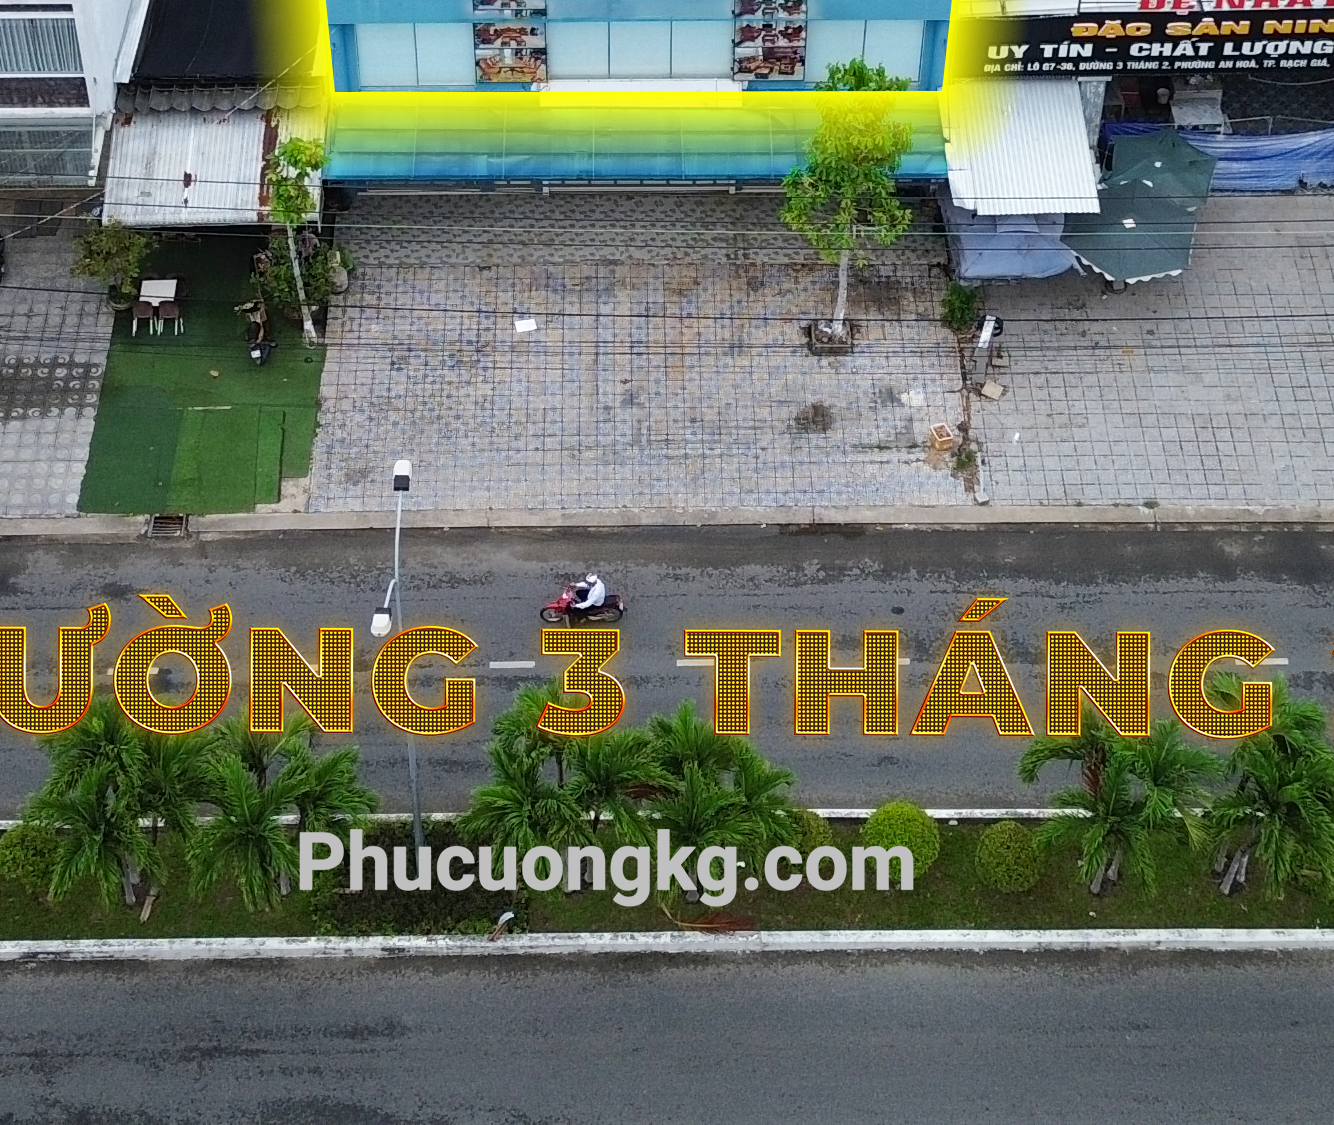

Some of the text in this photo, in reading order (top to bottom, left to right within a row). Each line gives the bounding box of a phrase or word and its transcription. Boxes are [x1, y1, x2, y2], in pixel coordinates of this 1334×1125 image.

[1071, 19, 1152, 39] ĐẶC
[987, 44, 1030, 60] UY
[1039, 40, 1094, 58] TÍN
[1129, 37, 1216, 57] CHẤT
[983, 63, 1001, 74] ĐỊA
[1027, 61, 1040, 72] LÔ
[1078, 59, 1114, 71] ĐƯỜNG
[1116, 61, 1124, 70] 3
[1126, 59, 1160, 70] THÁNG
[1173, 59, 1216, 70] PHƯỜNG
[1218, 60, 1234, 69] AN
[1262, 59, 1277, 68] TP.
[1279, 59, 1308, 70] RẠCH
